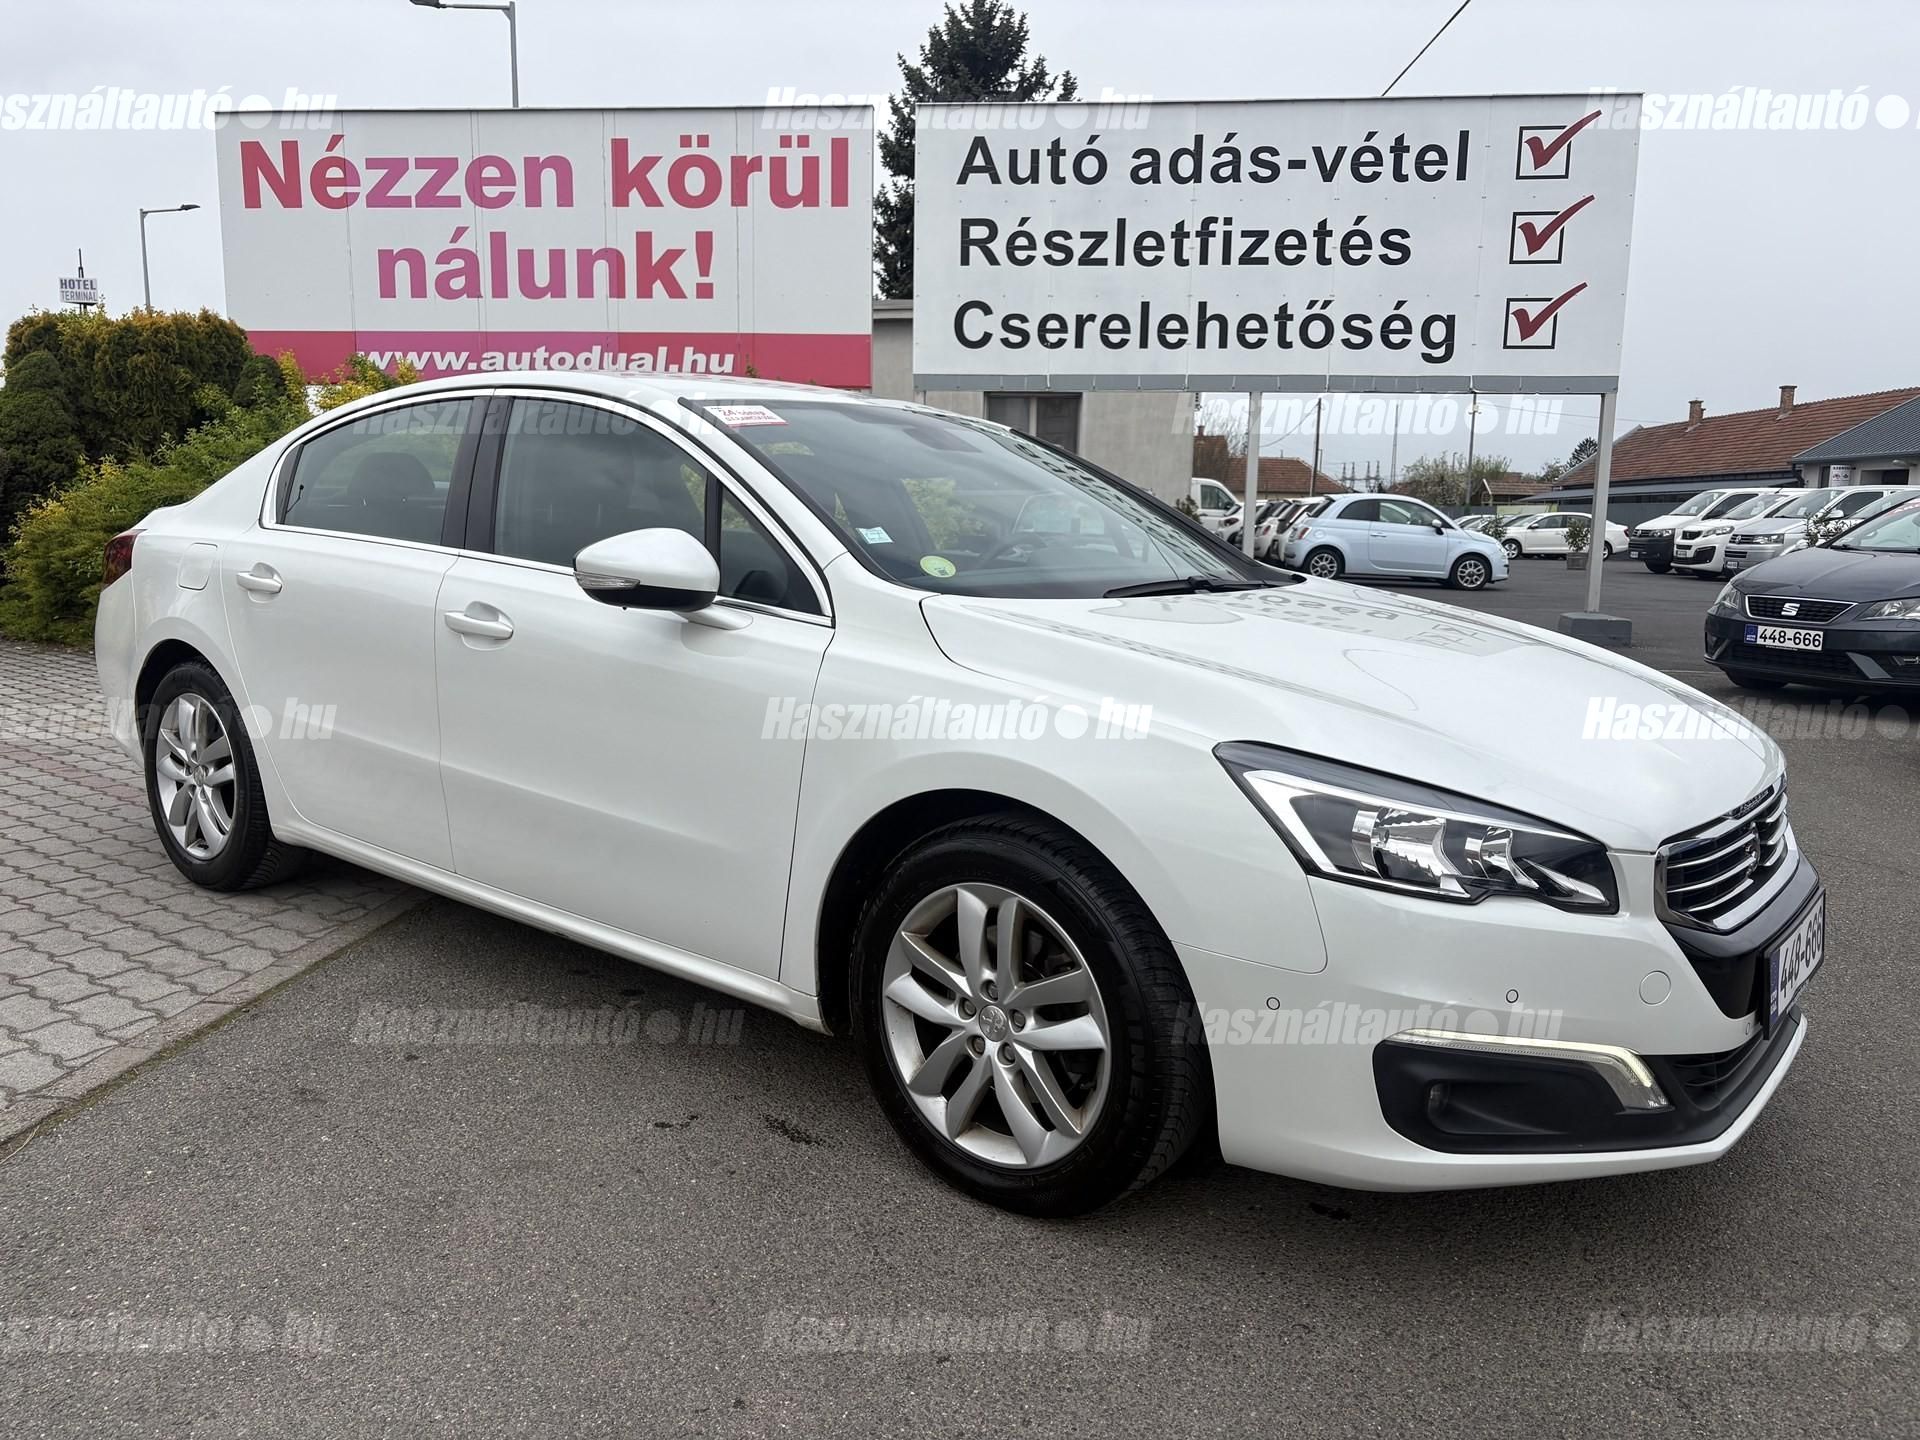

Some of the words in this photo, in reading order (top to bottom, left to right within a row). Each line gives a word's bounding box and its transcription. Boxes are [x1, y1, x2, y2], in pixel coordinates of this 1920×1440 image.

[241, 135, 574, 210] Nézzen
[612, 135, 849, 209] körül
[957, 135, 1108, 185] Autó
[1130, 130, 1470, 185] adás-vétel
[379, 227, 714, 300] nálunk!
[960, 216, 1411, 267] Részletfizetés
[60, 279, 96, 290] HOTEL
[60, 290, 98, 301] TERMINAL
[954, 300, 1456, 364] Cserelehetőség
[356, 345, 735, 375] www.autodual.hu
[1758, 628, 1822, 648] 448-666
[1779, 905, 1823, 999] 448-666
